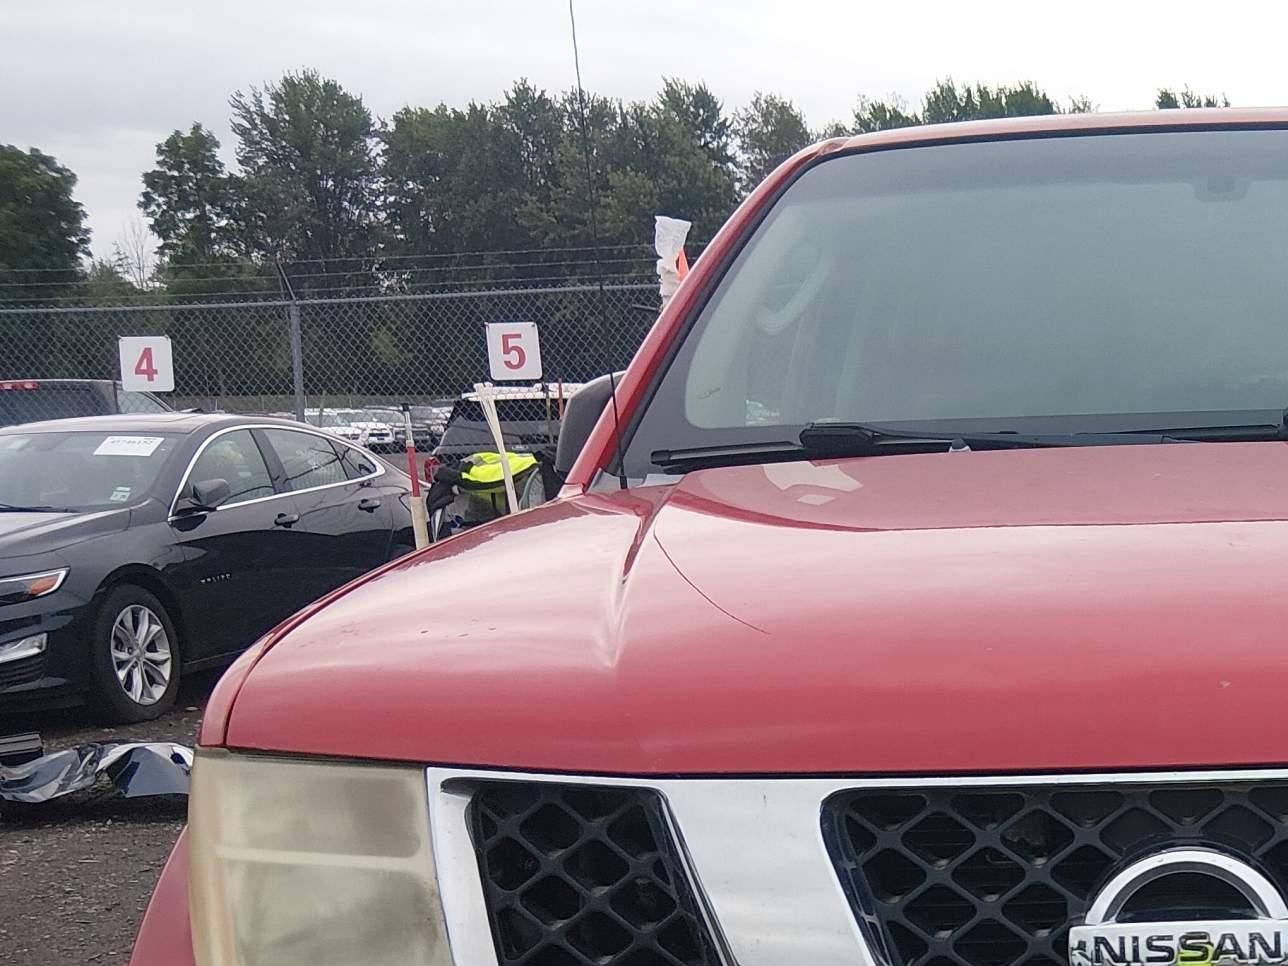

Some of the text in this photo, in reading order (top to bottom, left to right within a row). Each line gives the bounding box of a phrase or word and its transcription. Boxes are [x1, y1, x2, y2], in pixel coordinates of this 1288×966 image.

[134, 347, 158, 381] 4
[501, 333, 527, 370] 5
[1092, 930, 1284, 966] NISSAN
